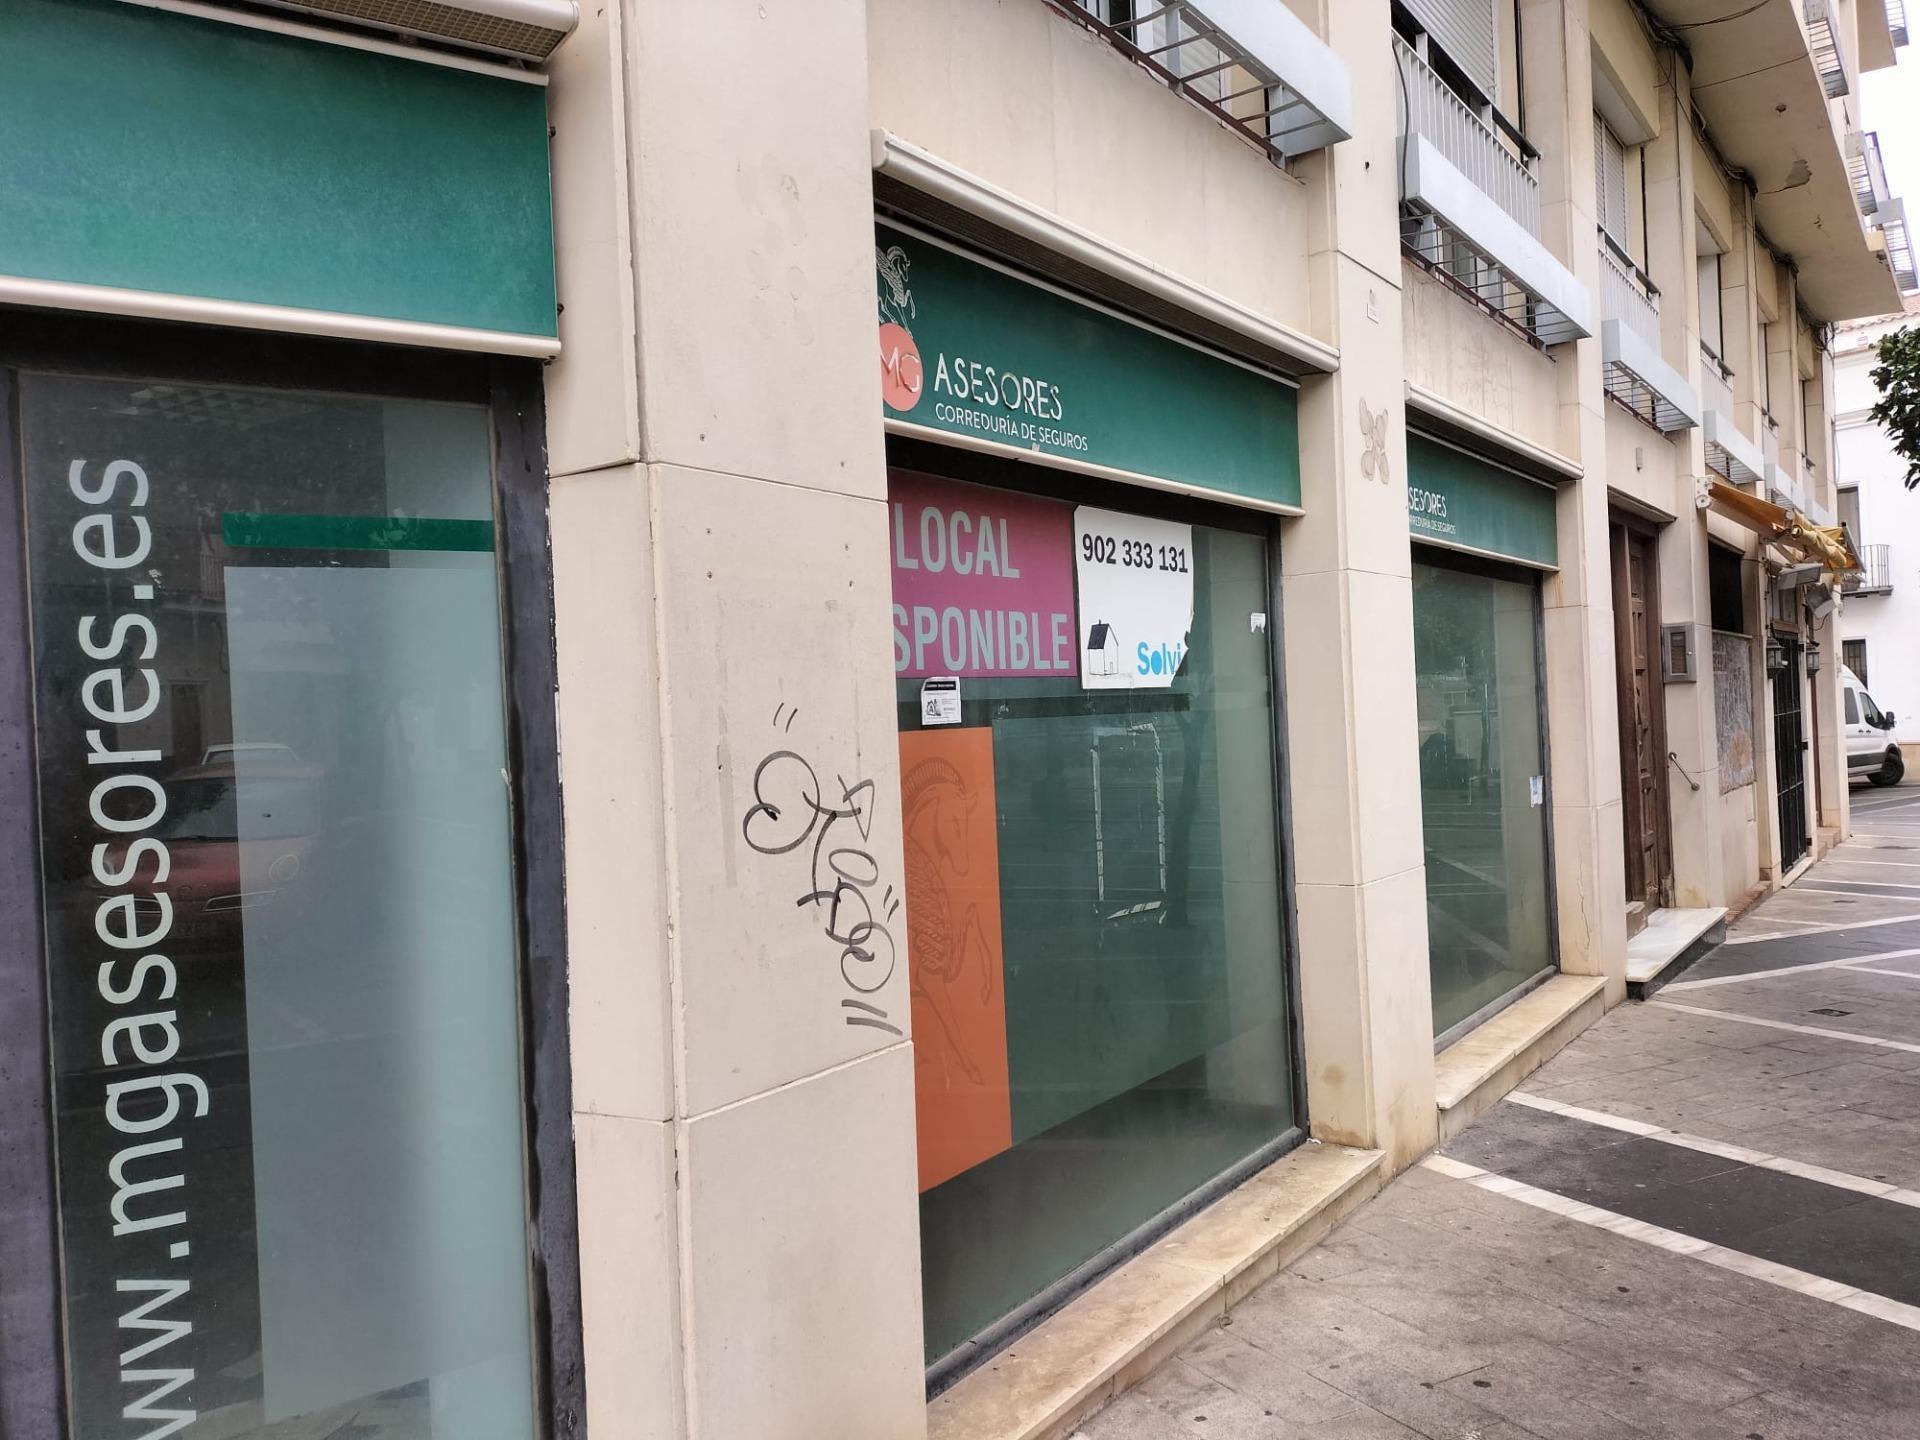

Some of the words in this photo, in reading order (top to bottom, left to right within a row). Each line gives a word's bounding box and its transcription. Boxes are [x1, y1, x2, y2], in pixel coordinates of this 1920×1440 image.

[934, 352, 1063, 422] ASESORES
[935, 402, 1019, 436] CORREDURÍA
[1021, 423, 1037, 441] DE
[1039, 427, 1088, 452] SEGUROS
[894, 503, 1020, 578] LOCAL
[1082, 533, 1117, 565] 902
[1122, 539, 1154, 569] 333
[1158, 545, 1188, 573] 131
[893, 603, 1070, 672] SPONIBLE
[1137, 641, 1182, 676] Solvi
